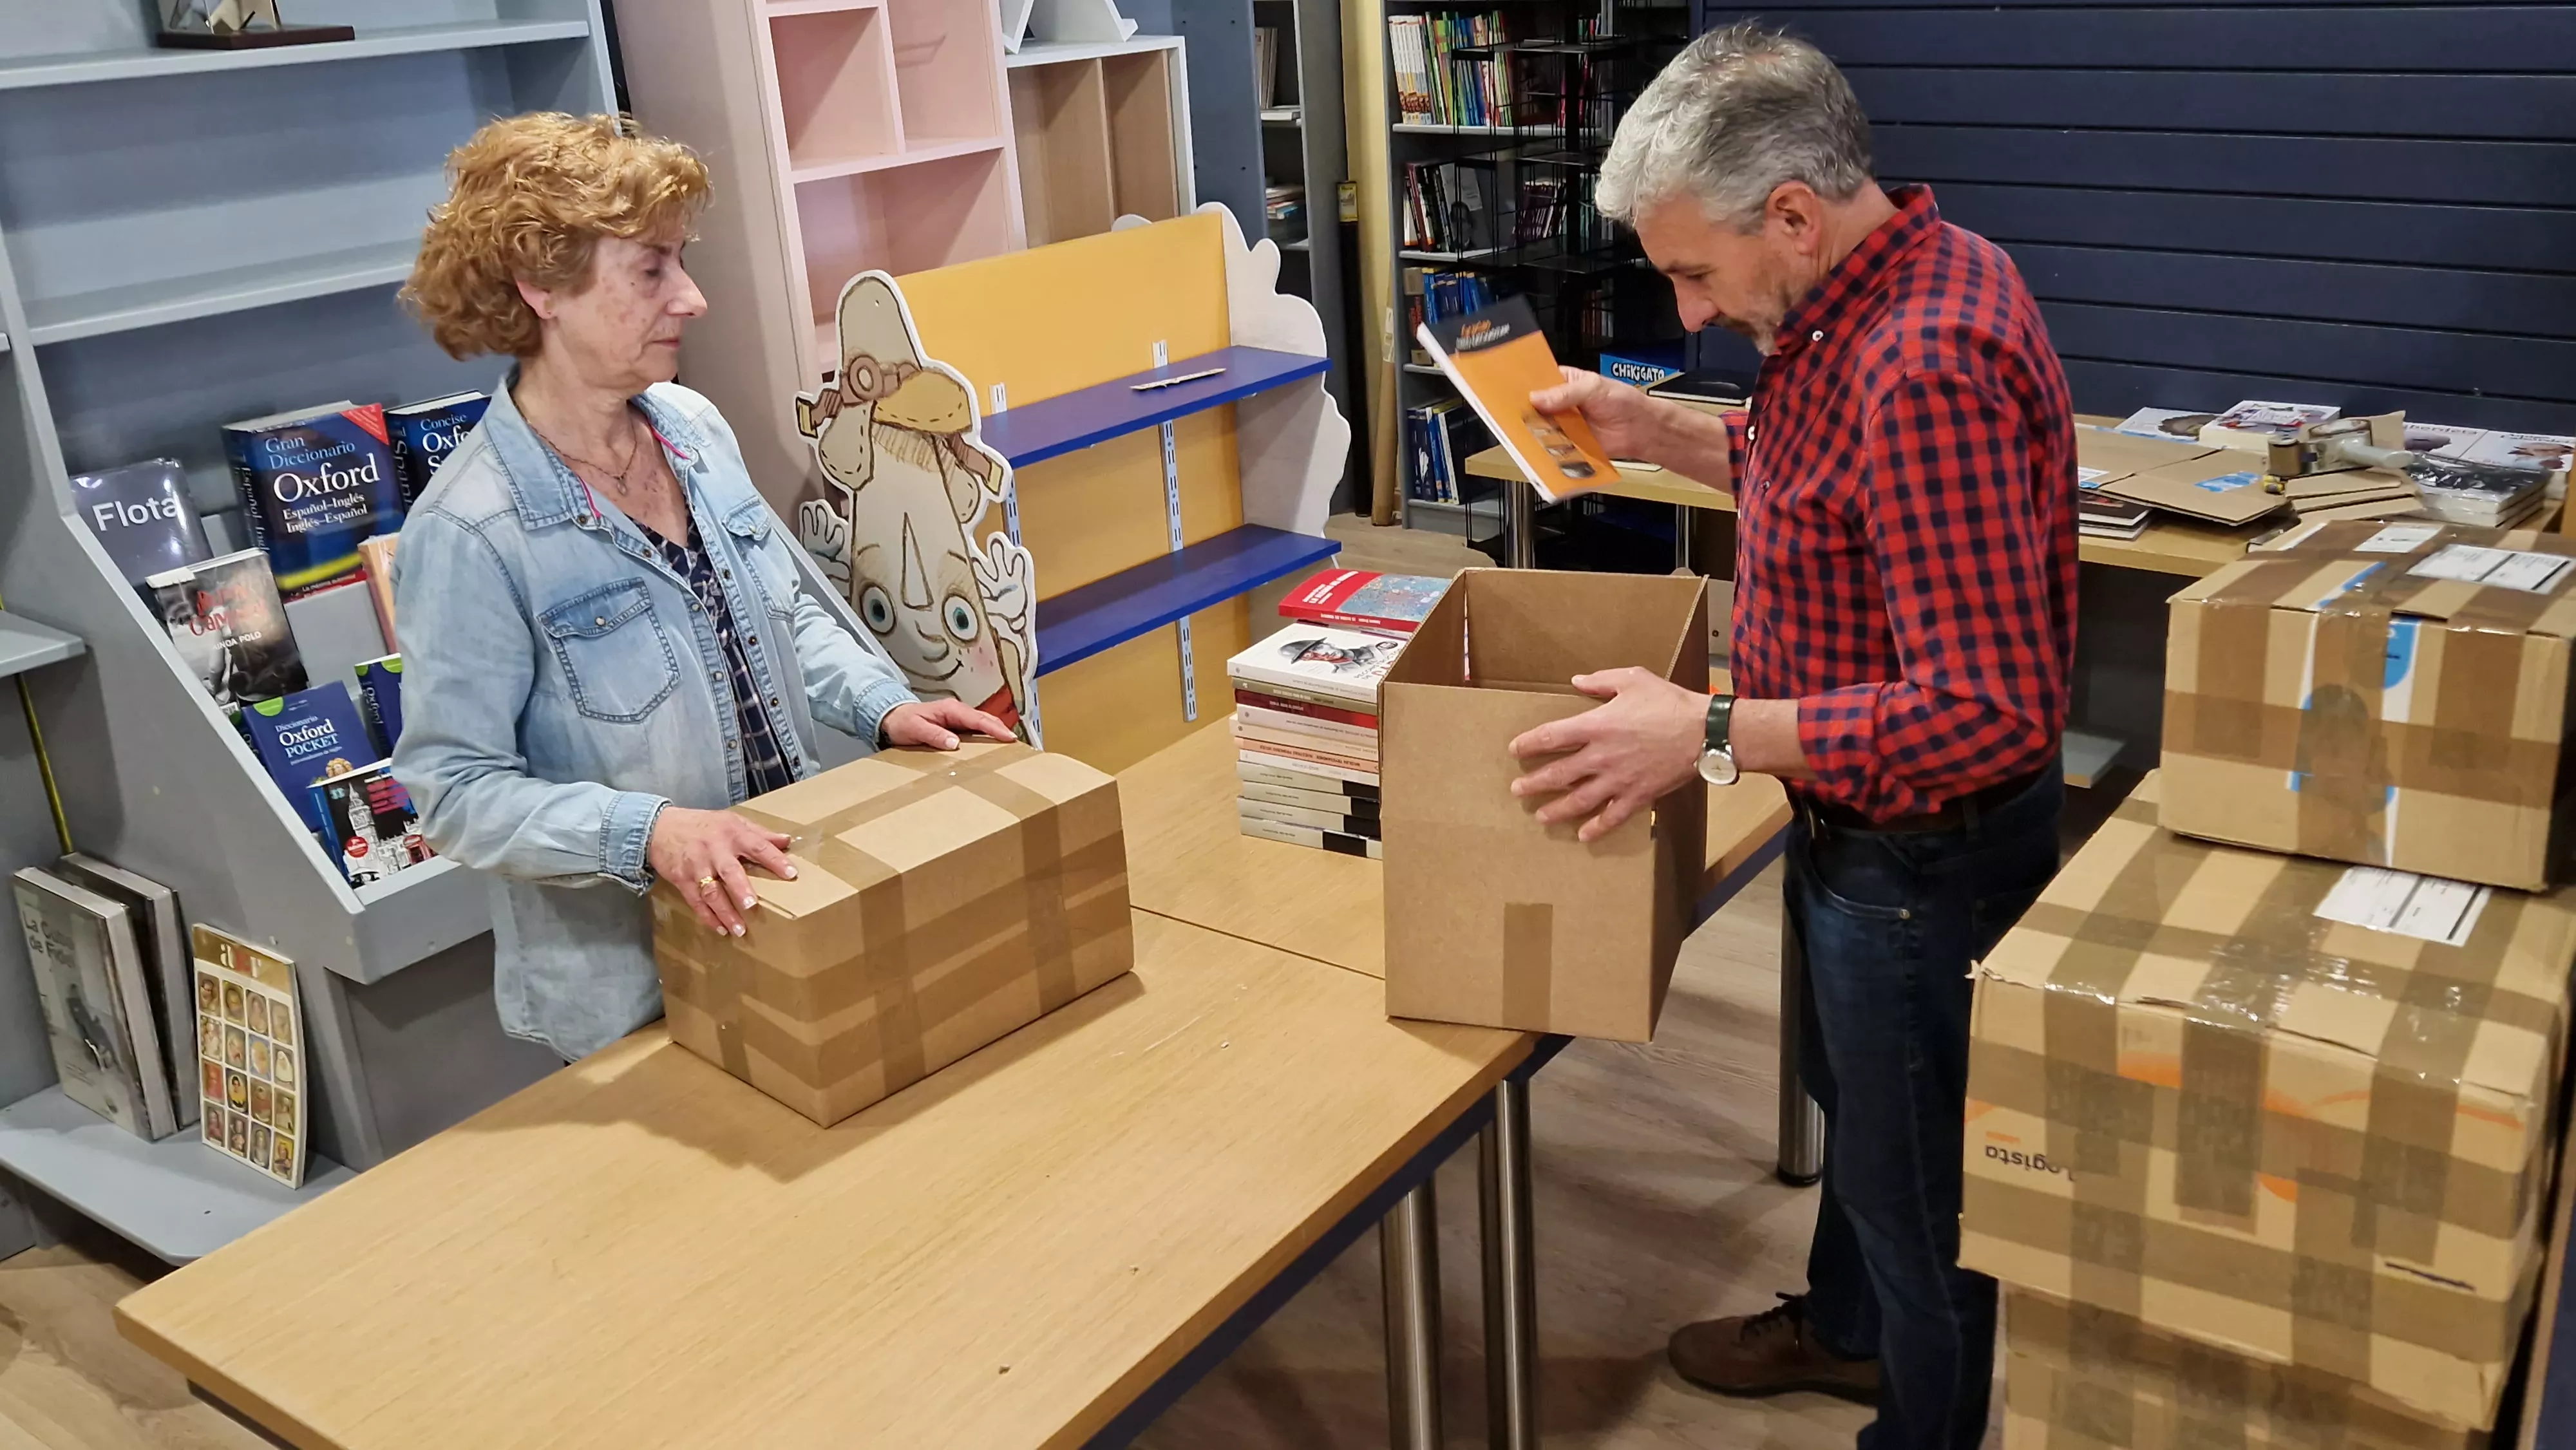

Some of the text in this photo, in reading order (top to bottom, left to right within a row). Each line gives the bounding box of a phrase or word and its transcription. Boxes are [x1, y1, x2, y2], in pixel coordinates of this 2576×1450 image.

[421, 414, 467, 431] Concise
[265, 435, 305, 454] Gran
[269, 440, 356, 470] Diccionario
[273, 453, 381, 503] Oxford
[91, 496, 178, 532] Flota
[238, 630, 263, 643] POLO
[275, 715, 319, 733] Diccionario
[279, 718, 336, 748] Oxford
[284, 733, 339, 758] POCKET
